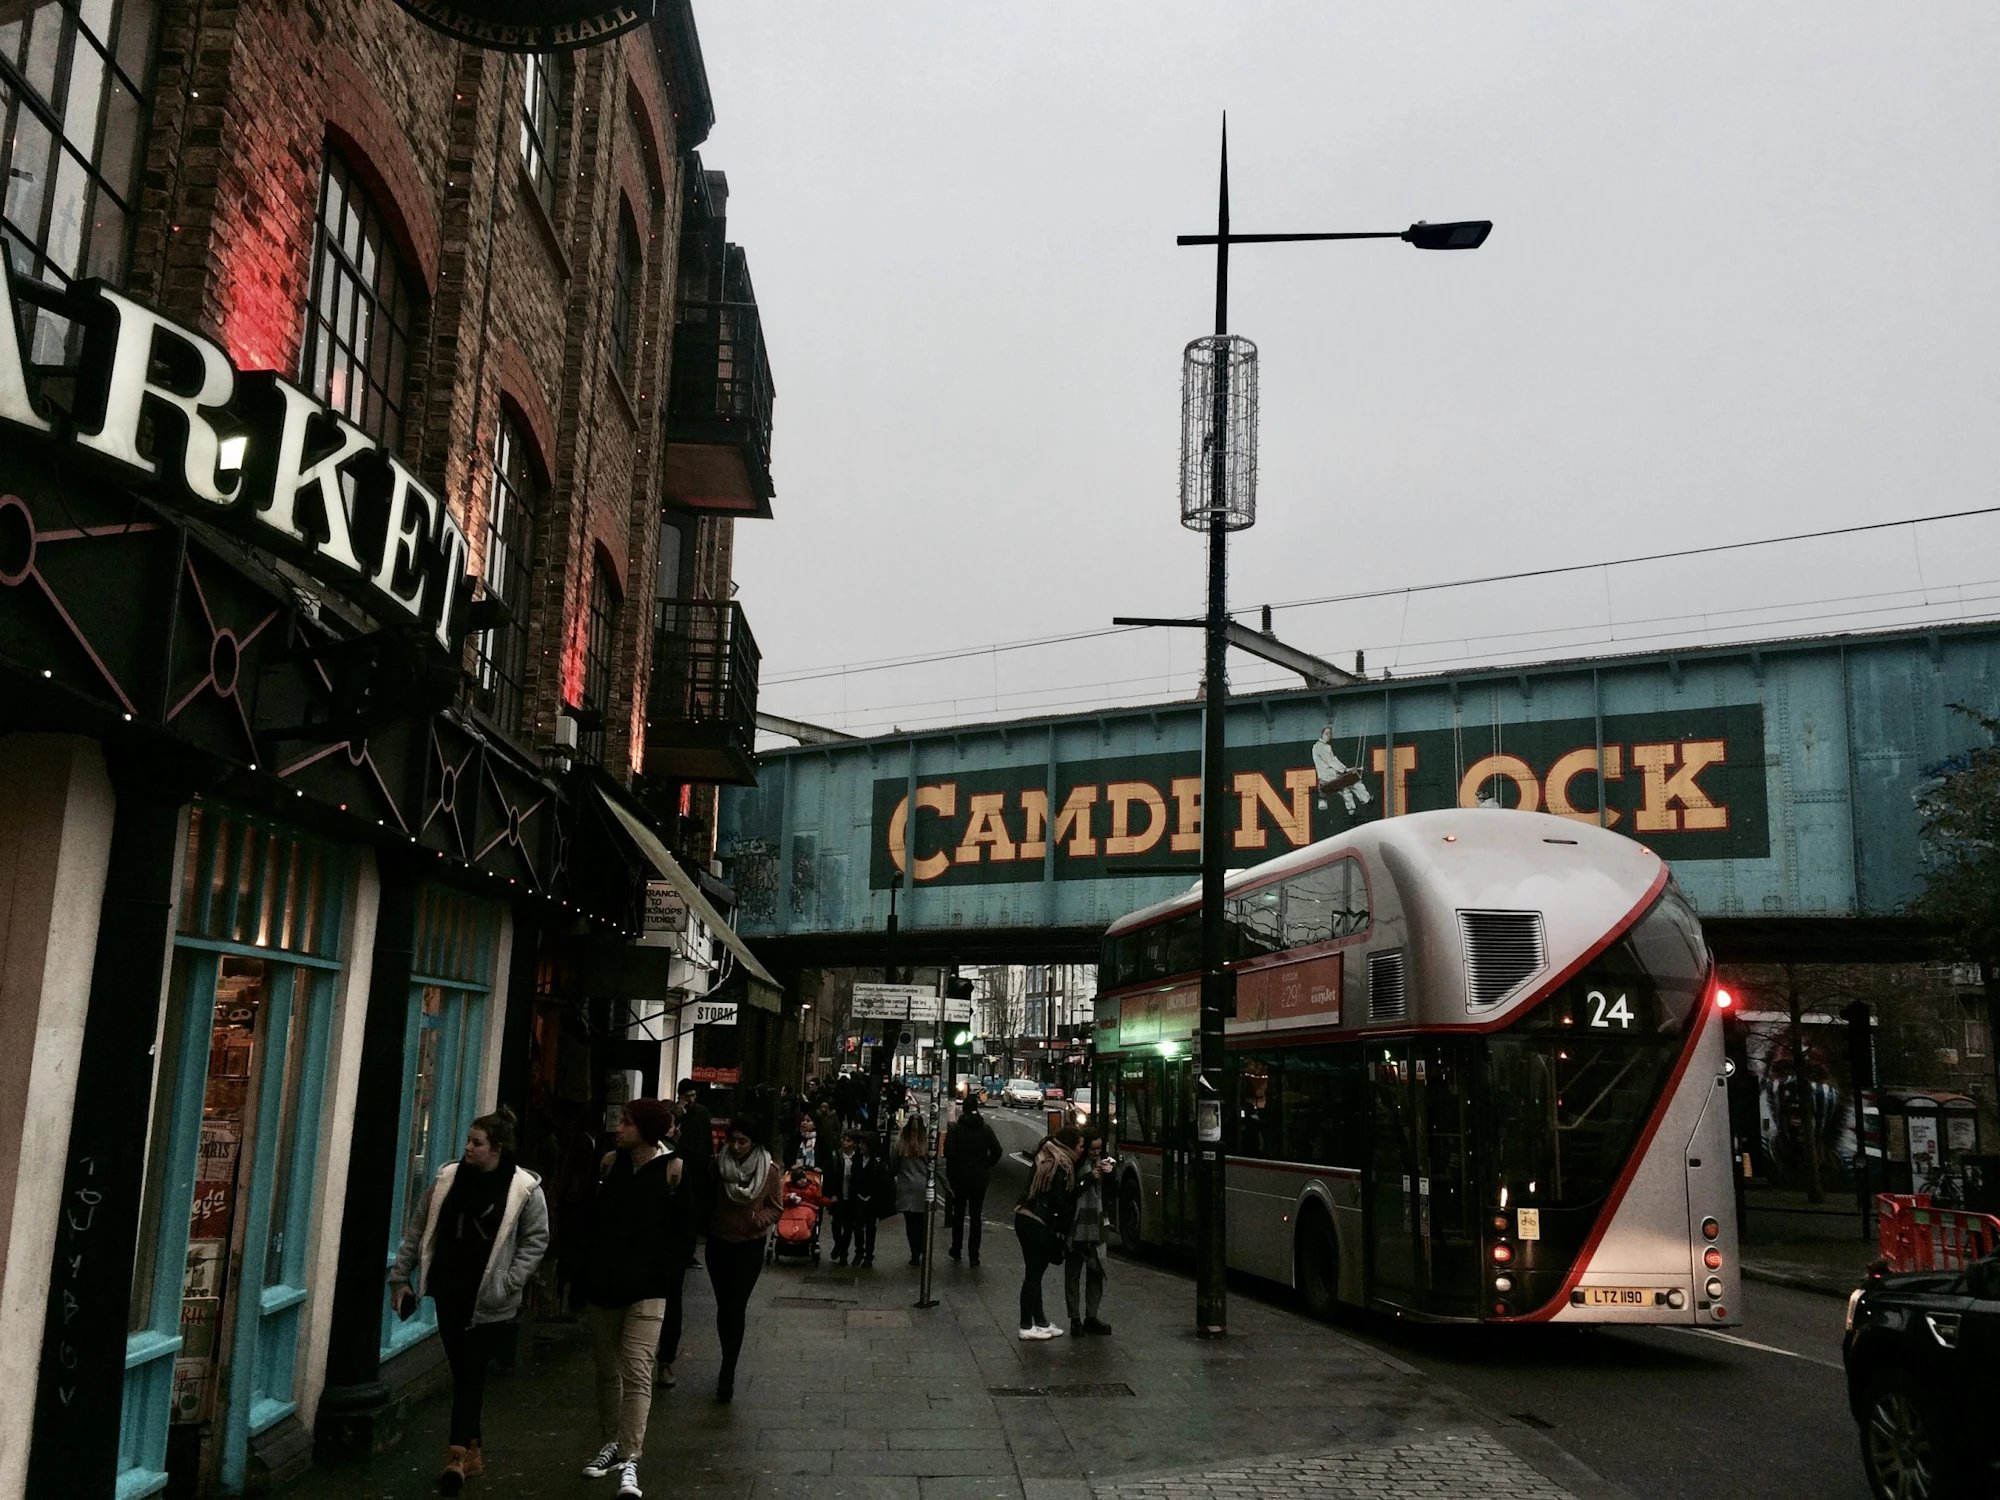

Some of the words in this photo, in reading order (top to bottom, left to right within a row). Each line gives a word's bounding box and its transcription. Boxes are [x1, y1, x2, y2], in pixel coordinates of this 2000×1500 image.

[553, 5, 637, 44] HALL
[651, 898, 661, 906] TO
[1311, 988, 1336, 1004] easyJet
[697, 1006, 733, 1021] STORM
[1587, 990, 1634, 1029] 24
[1594, 1290, 1617, 1303] LTZ
[1621, 1291, 1642, 1304] 1190
